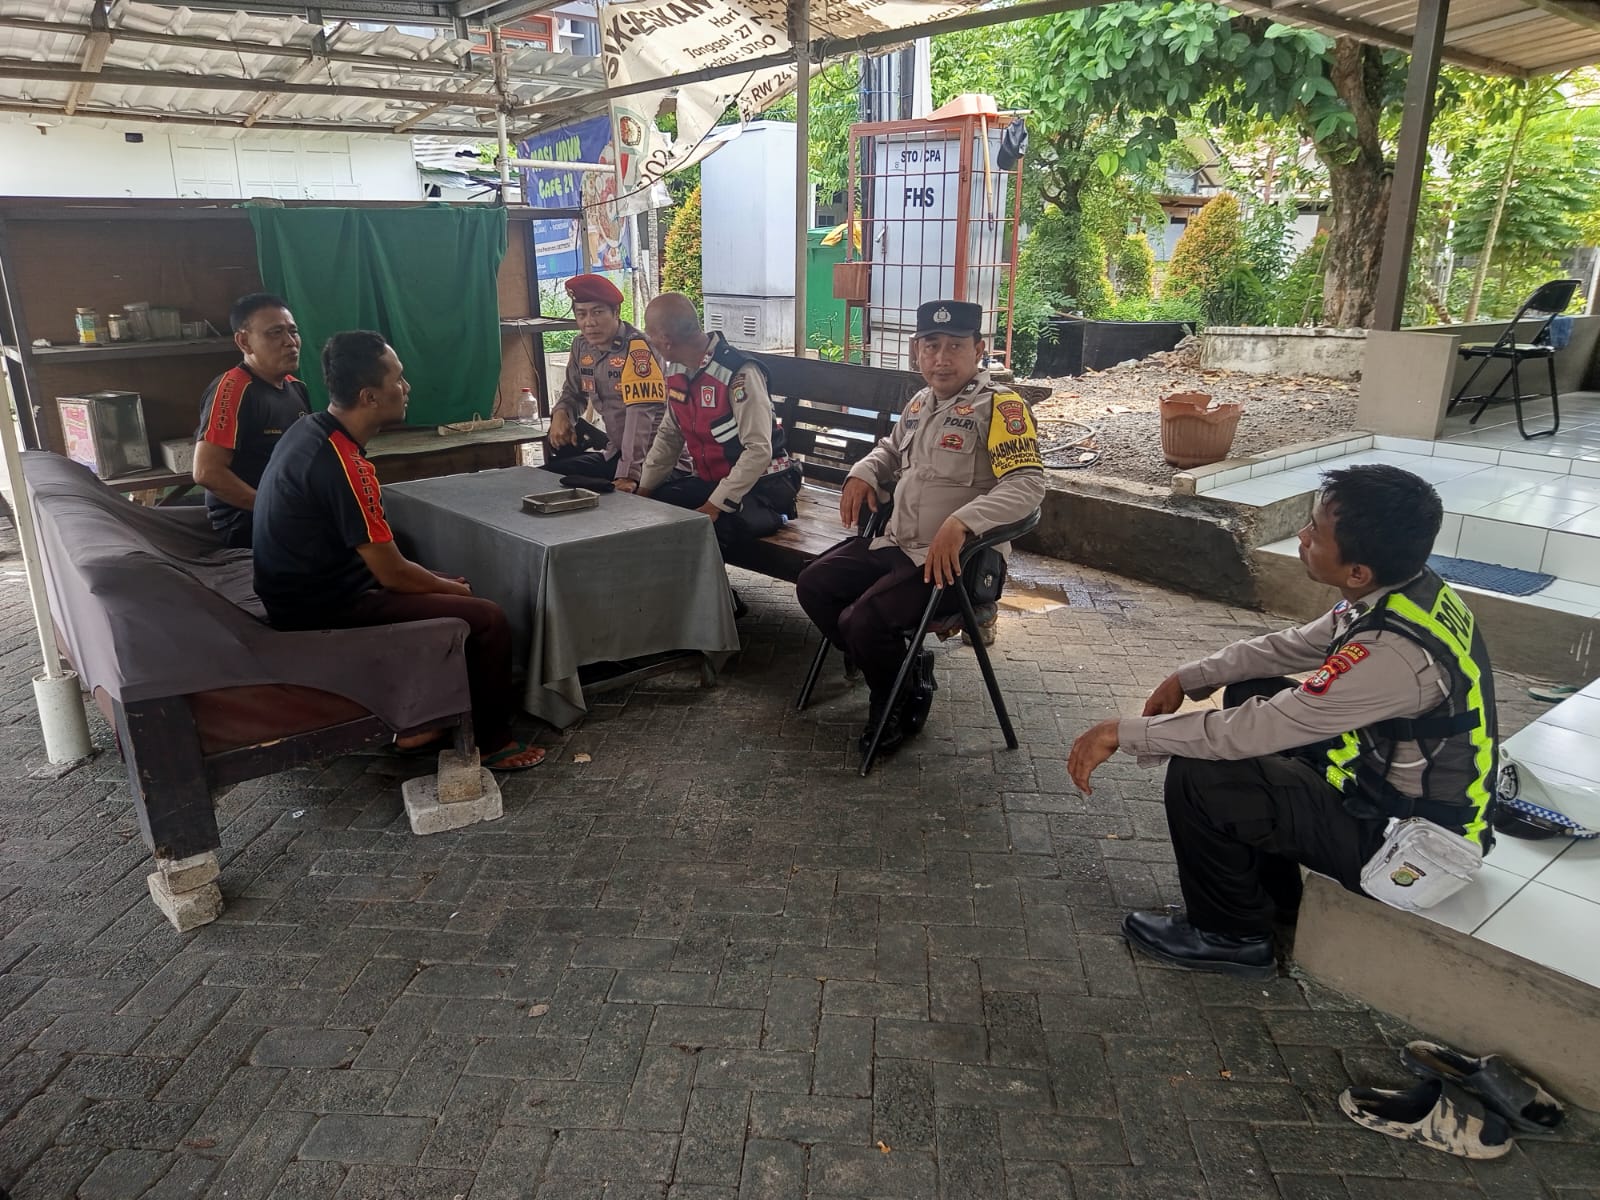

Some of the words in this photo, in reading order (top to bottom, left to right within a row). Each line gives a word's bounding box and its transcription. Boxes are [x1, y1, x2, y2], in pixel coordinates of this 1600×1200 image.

[708, 7, 741, 28] Hari
[682, 34, 734, 59] Tanggal
[734, 24, 753, 40] 27
[751, 79, 773, 102] RW
[773, 72, 792, 87] 24
[901, 150, 918, 163] STO
[925, 149, 941, 162] CPA
[538, 177, 563, 199] CAFE
[564, 172, 574, 193] 24
[904, 187, 934, 208] FHS
[624, 382, 664, 400] PAWAS
[943, 416, 975, 431] POLRI
